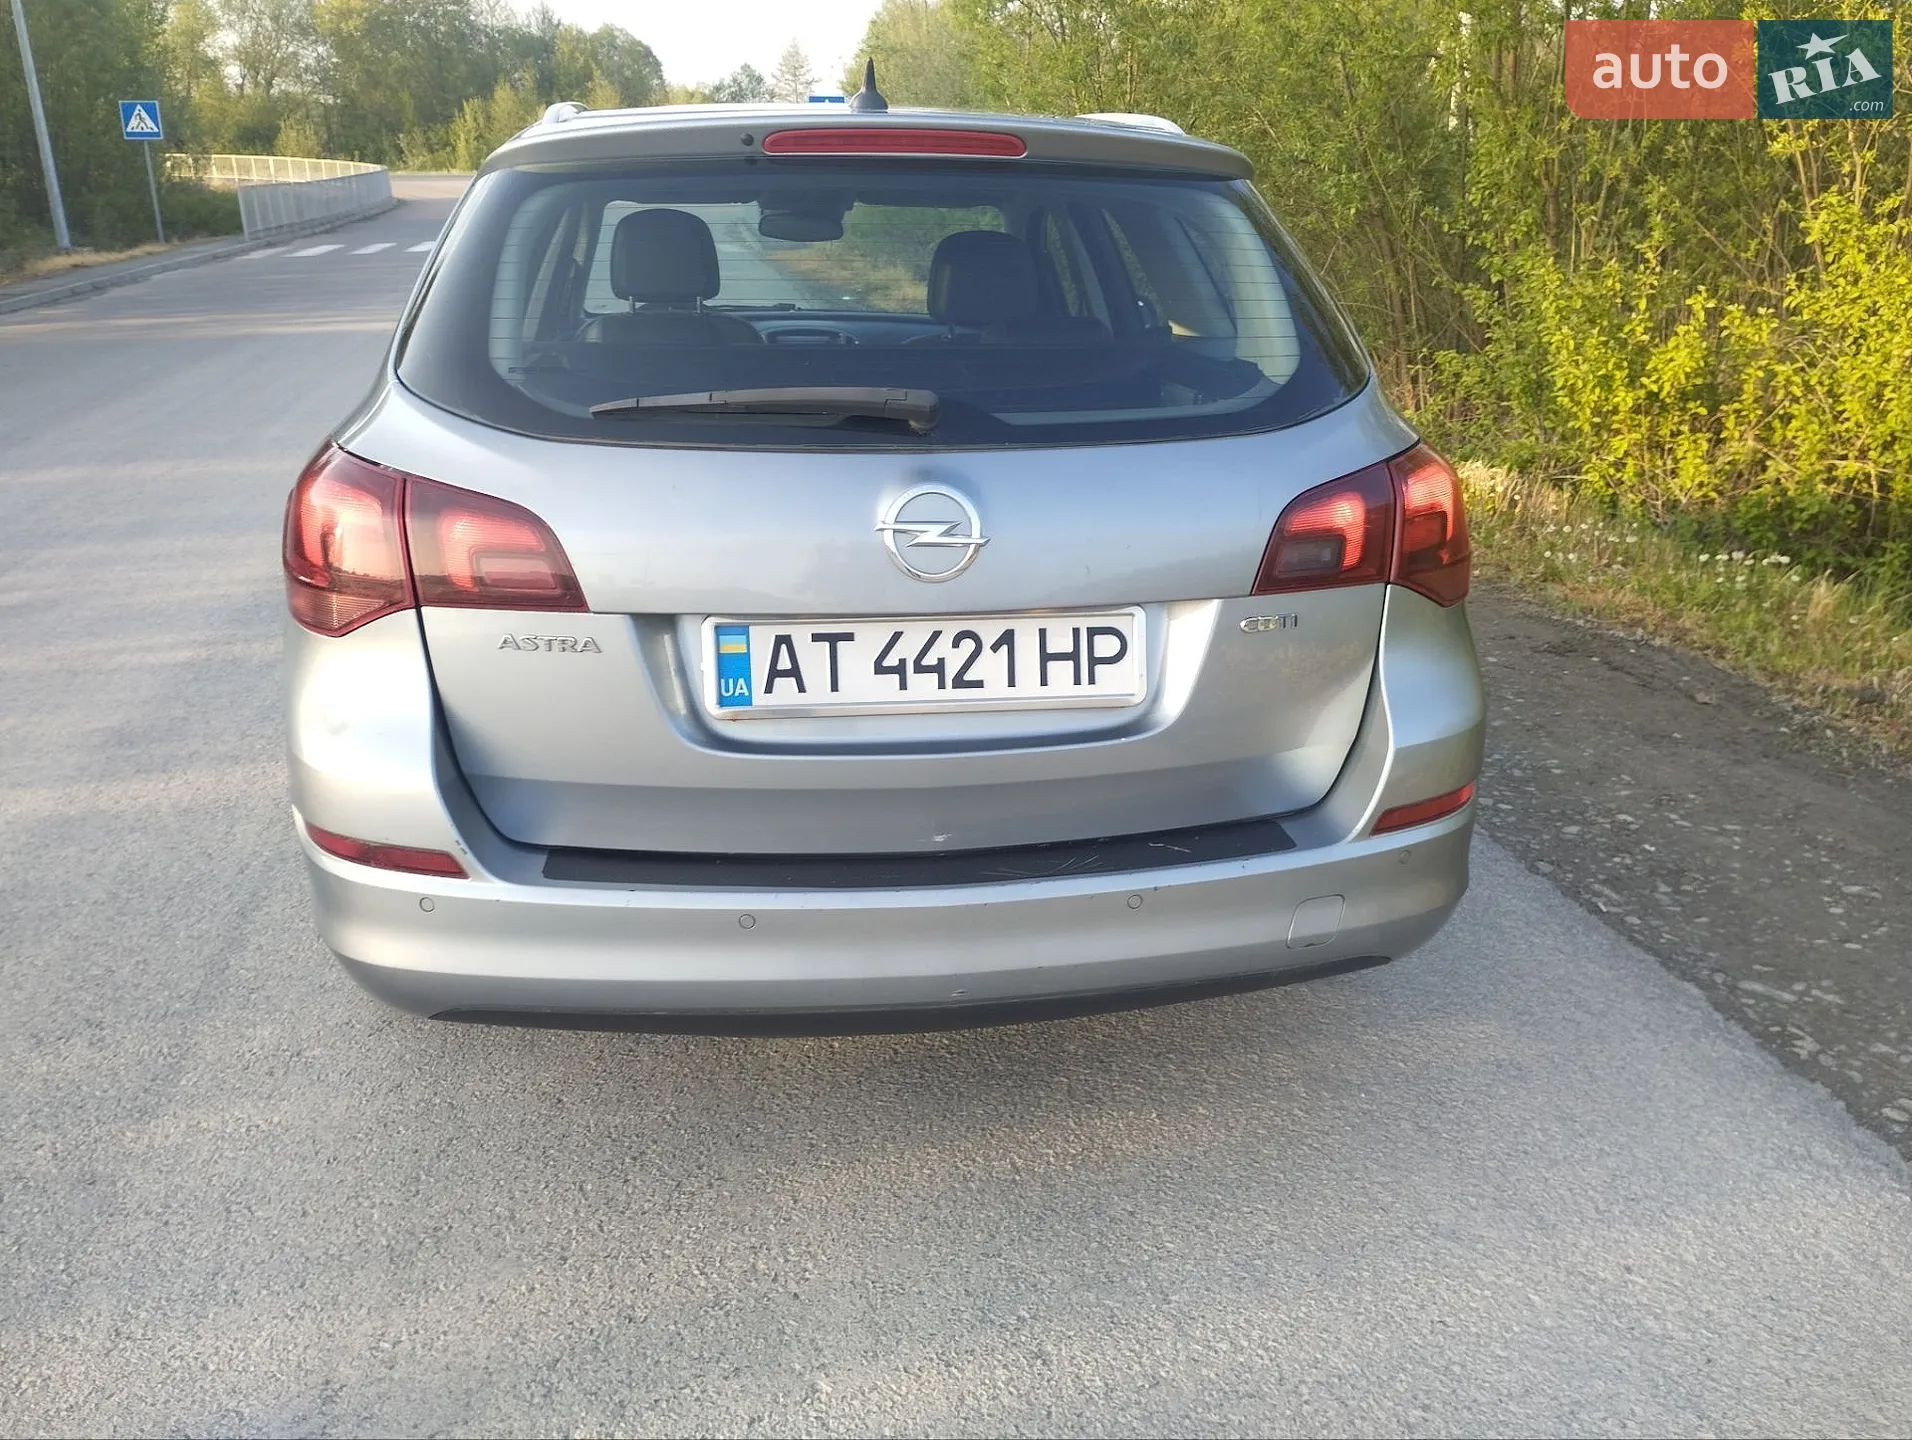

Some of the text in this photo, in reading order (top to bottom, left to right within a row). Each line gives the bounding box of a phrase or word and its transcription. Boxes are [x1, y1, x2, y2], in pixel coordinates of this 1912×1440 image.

[498, 633, 603, 653] ASTRA
[764, 626, 1128, 694] AT 4421 HP
[721, 678, 749, 696] UA
